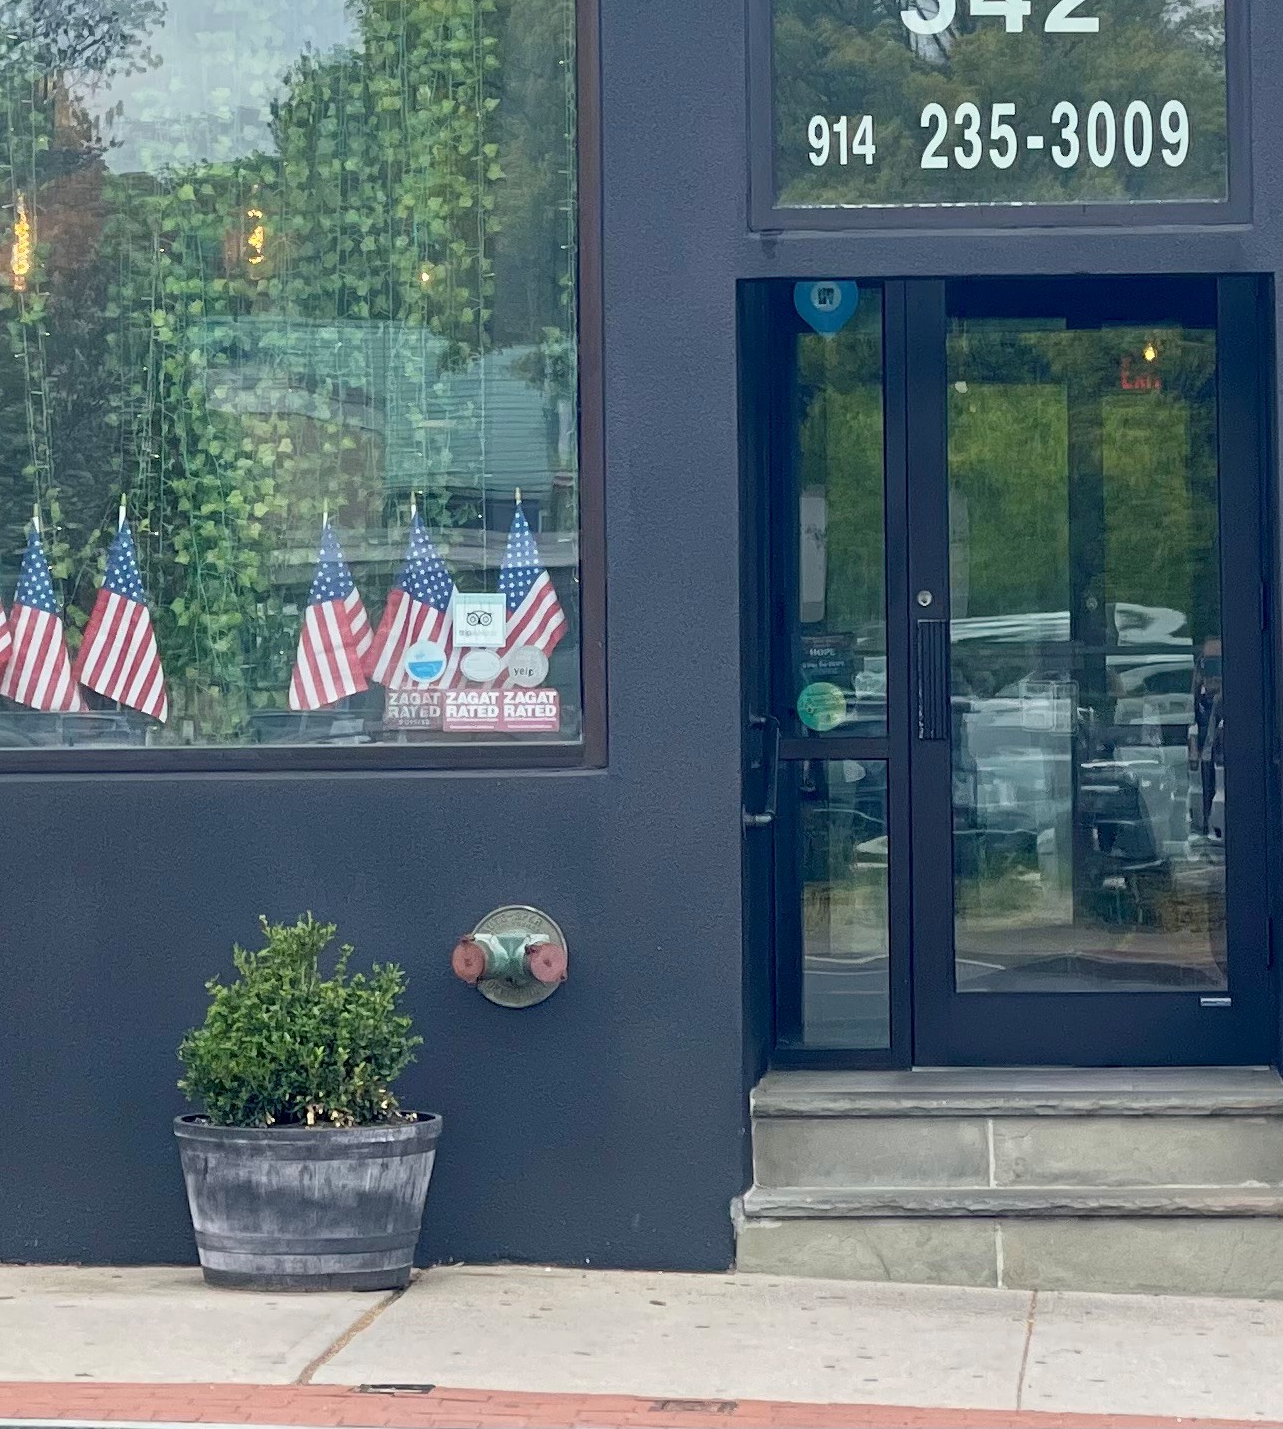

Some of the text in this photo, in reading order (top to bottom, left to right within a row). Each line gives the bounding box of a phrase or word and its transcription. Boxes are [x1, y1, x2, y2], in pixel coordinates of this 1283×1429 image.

[807, 99, 1190, 169] 914 235-3009
[445, 691, 499, 705] ZAGAT
[503, 691, 557, 705] ZAGAT
[445, 704, 499, 718] RATED
[503, 704, 557, 718] RATED
